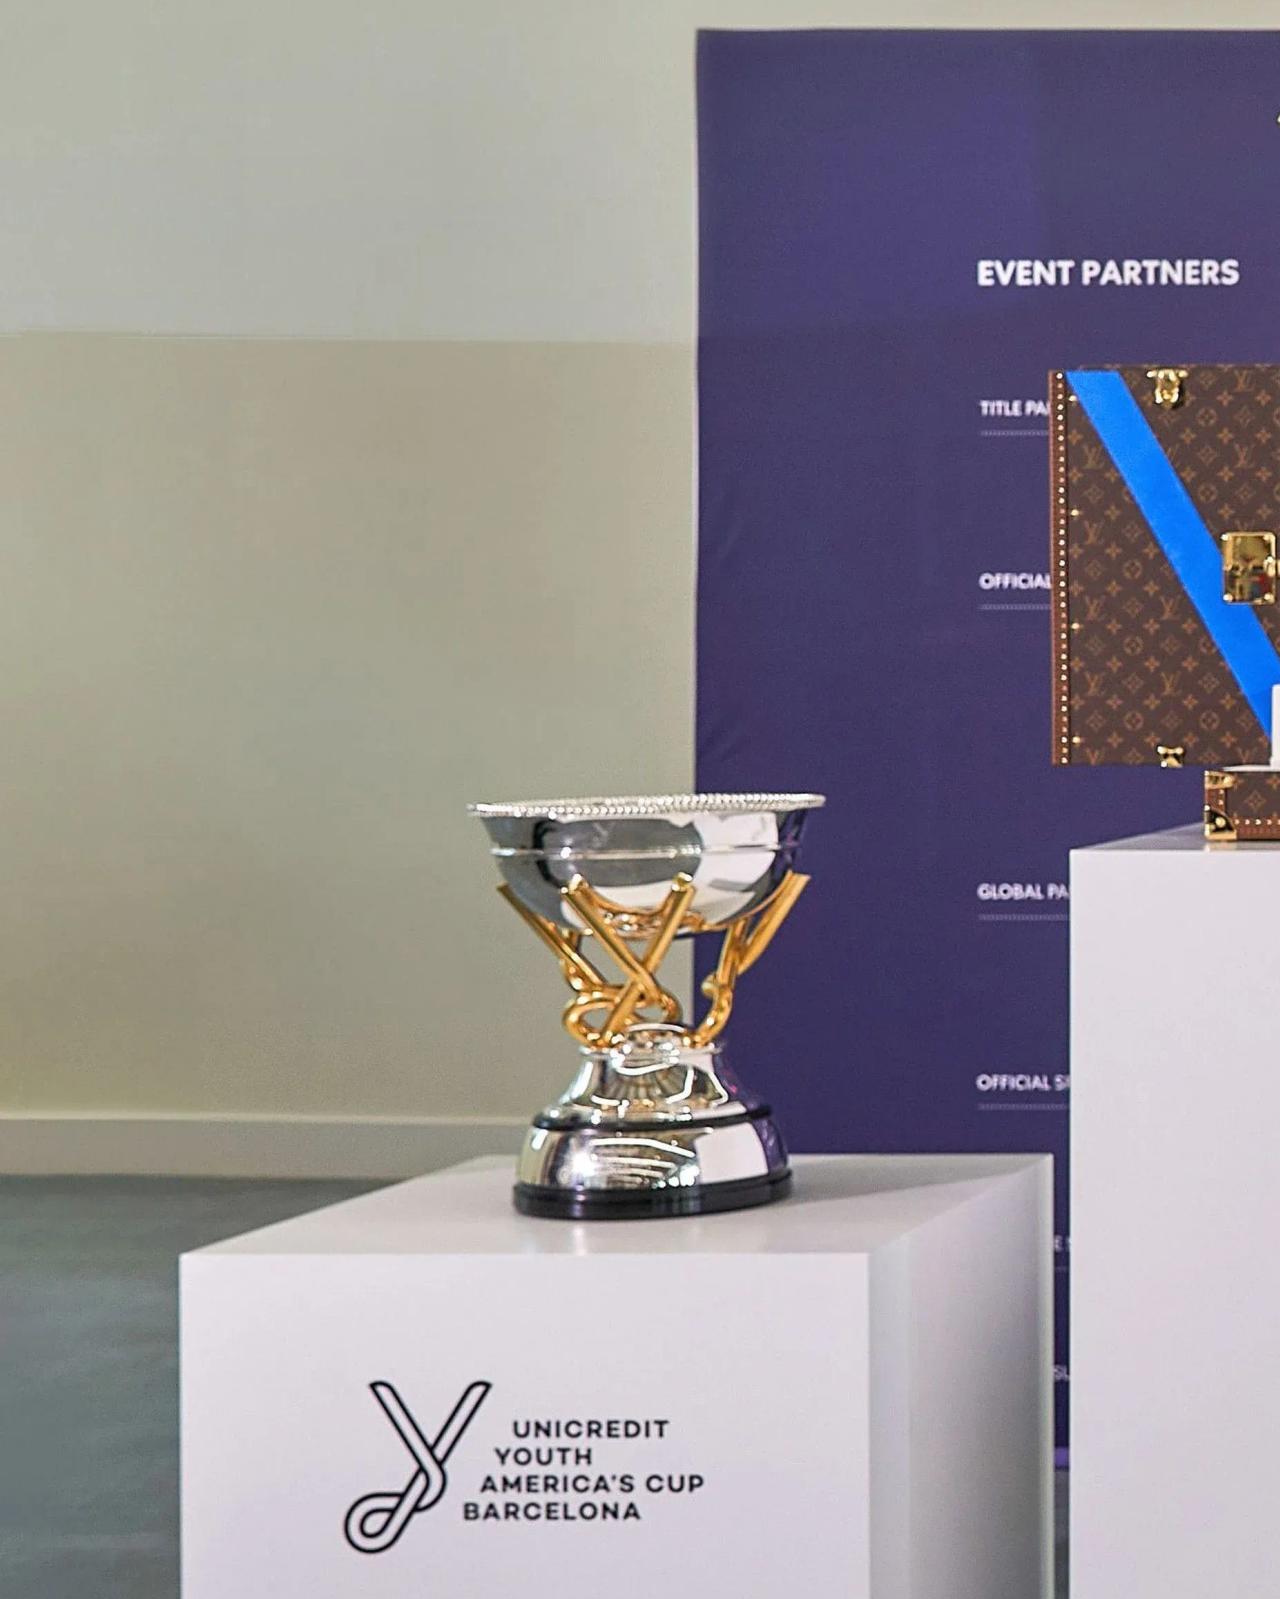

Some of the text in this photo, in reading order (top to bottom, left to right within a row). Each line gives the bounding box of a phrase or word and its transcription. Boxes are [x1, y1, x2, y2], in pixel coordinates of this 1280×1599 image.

[978, 259, 1239, 286] EVENT PARTNERS
[980, 400, 1022, 416] TITLE
[979, 572, 1052, 589] OFFICIAL
[977, 883, 1044, 900] GLOBAL
[976, 1074, 1051, 1091] OFFICIAL
[513, 1419, 669, 1439] UNICREDIT
[495, 1447, 592, 1466] YOUTH
[480, 1474, 704, 1494] AMERICA'S CUP
[463, 1502, 641, 1521] BARCELONA
